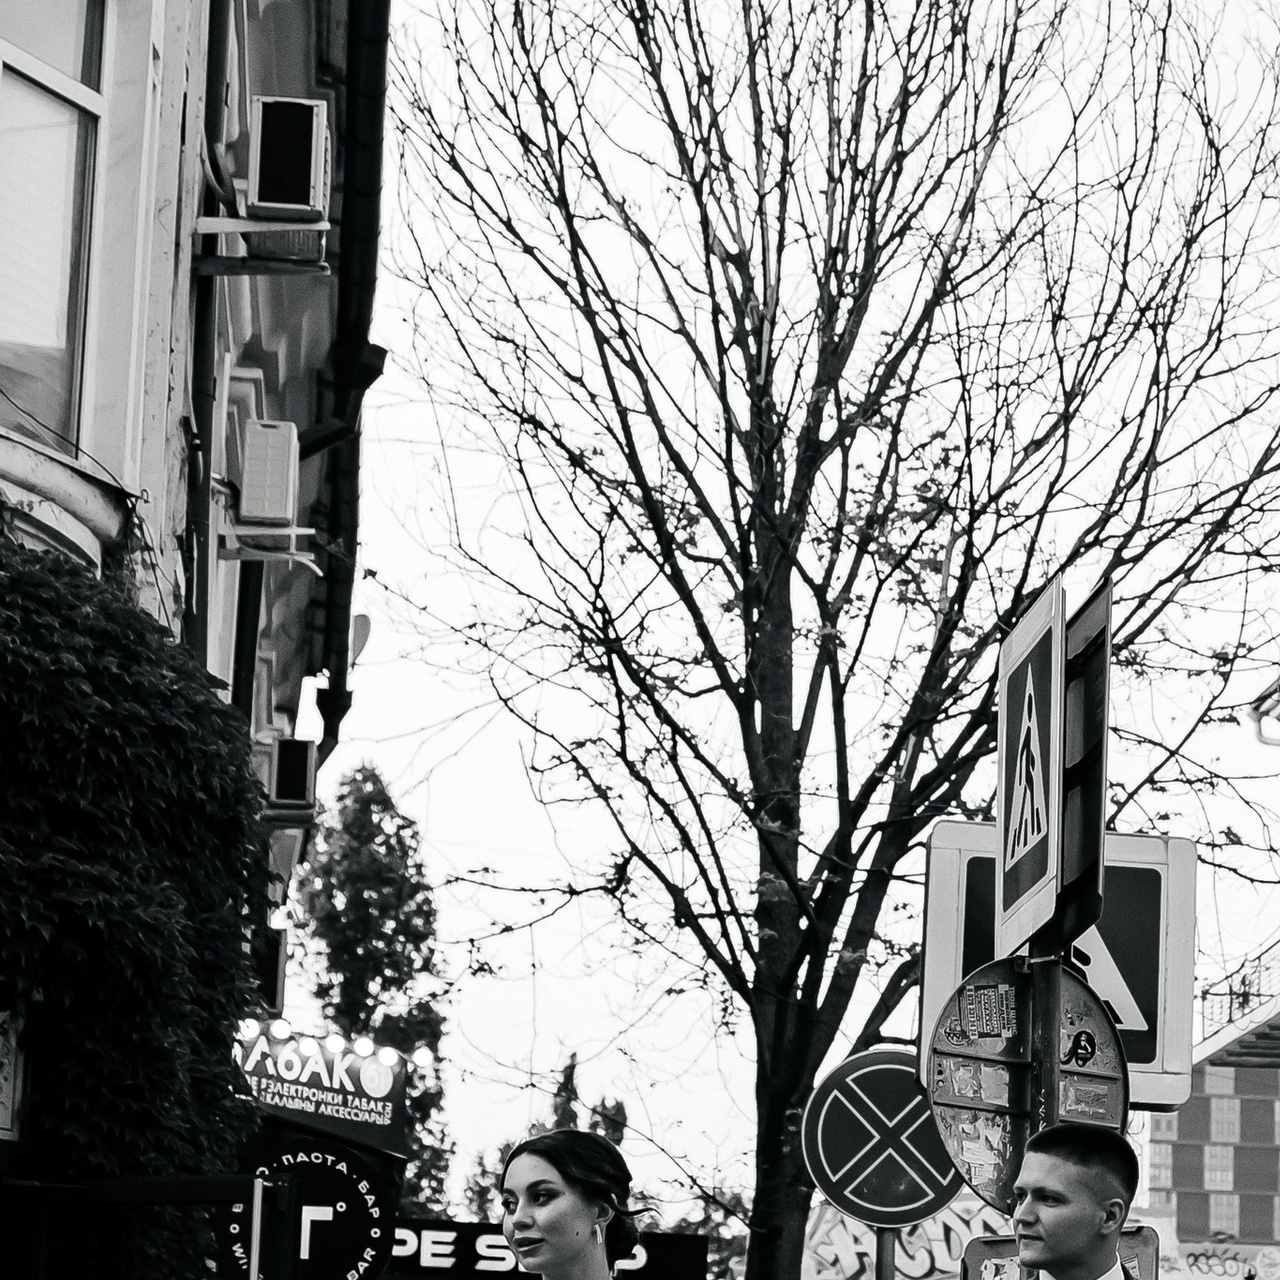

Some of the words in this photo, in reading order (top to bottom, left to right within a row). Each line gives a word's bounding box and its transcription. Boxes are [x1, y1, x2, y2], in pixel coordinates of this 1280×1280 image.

[265, 1092, 316, 1113] КАЛЬЯНЫ
[346, 1095, 384, 1113] ТАБАК
[281, 1152, 348, 1175] ПАСТА
[357, 1180, 380, 1219] БАР
